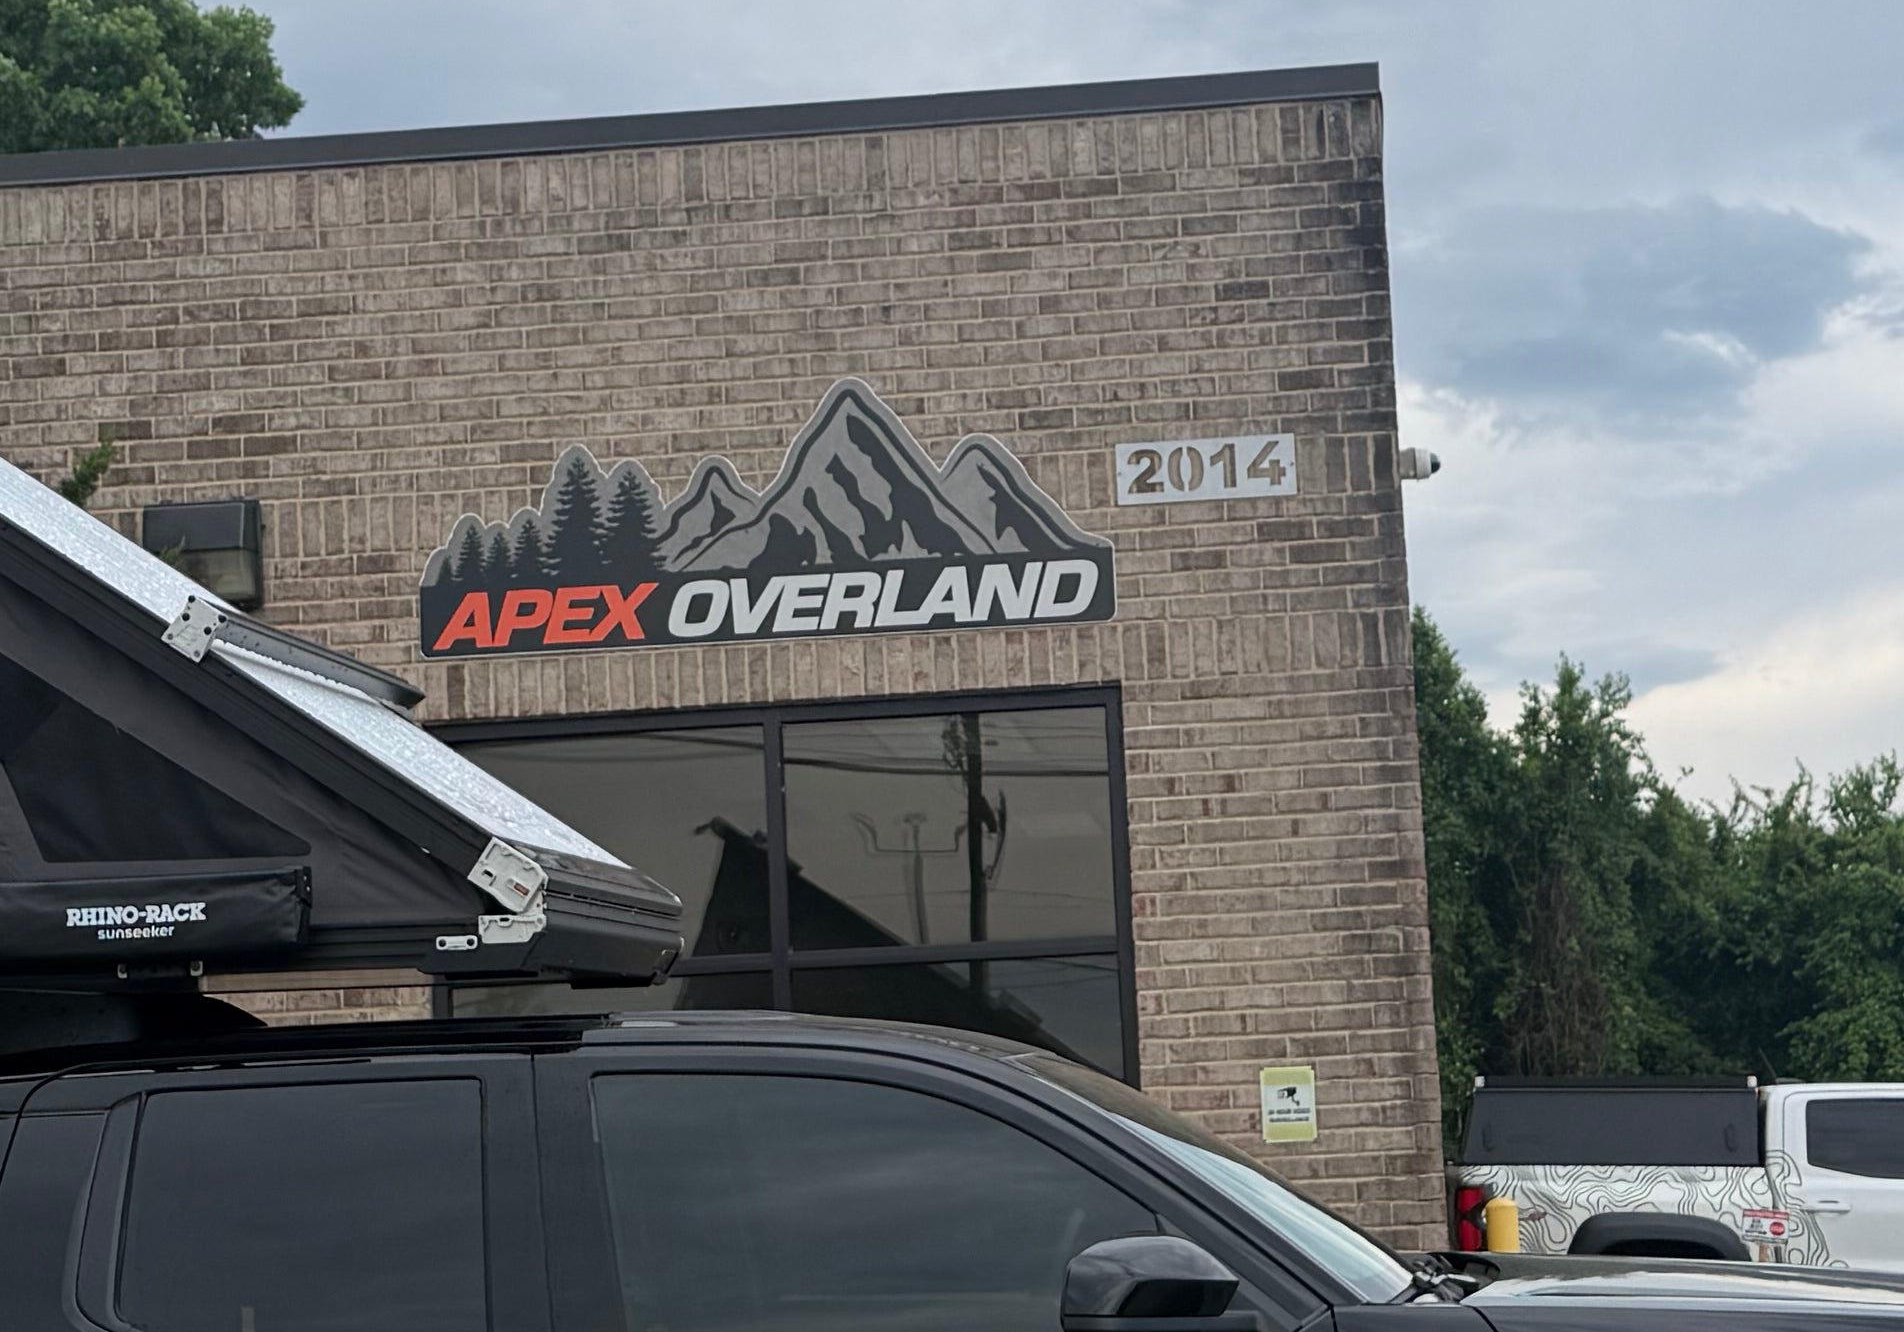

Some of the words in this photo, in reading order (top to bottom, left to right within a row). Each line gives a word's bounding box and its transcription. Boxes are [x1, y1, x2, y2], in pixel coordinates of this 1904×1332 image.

[1126, 440, 1287, 495] 2014
[432, 581, 660, 651] APEX
[667, 558, 1100, 637] OVERLAND
[65, 902, 207, 927] RHINO-RACK
[97, 924, 175, 940] sunseeker
